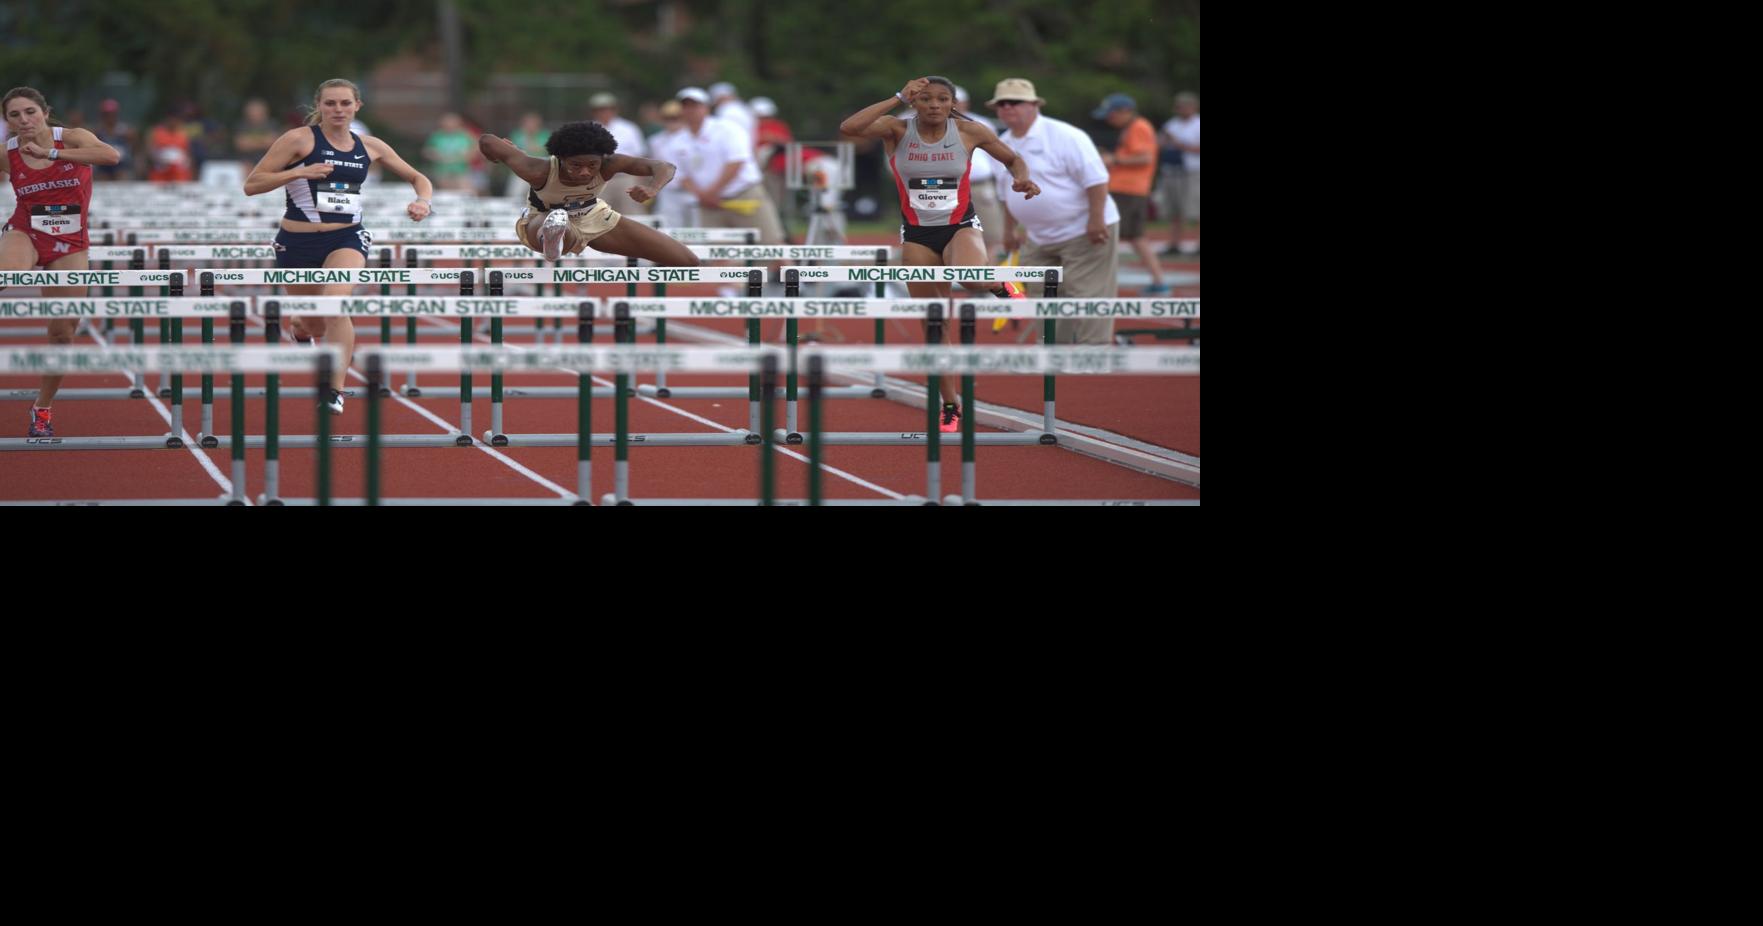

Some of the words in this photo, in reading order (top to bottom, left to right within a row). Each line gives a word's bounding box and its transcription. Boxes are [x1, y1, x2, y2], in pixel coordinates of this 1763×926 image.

[908, 152, 929, 161] OHIO
[931, 152, 954, 161] STATE
[17, 178, 80, 196] NEBRASKA
[327, 196, 351, 205] Black
[53, 241, 71, 253] N
[212, 247, 275, 258] MICHIGA
[459, 247, 534, 258] MICHIGAN
[709, 247, 784, 258] MICHIGAN
[790, 247, 834, 258] STATE
[0, 272, 59, 286] HIGAN
[67, 272, 120, 286] STATE
[148, 274, 170, 282] UCS
[223, 273, 244, 281] UCS
[263, 270, 350, 283] MICHIGAN
[358, 270, 411, 283] STATE
[439, 272, 460, 280] UCS
[513, 271, 534, 279] UCS
[553, 269, 640, 282] MICHIGAN
[647, 269, 700, 282] STATE
[728, 271, 749, 279] UCS
[808, 270, 829, 278] UCS
[848, 268, 935, 281] MICHIGAN
[943, 268, 995, 281] STATE
[1023, 270, 1044, 278] UCS
[106, 300, 169, 315] STATE
[293, 302, 317, 311] UCS
[340, 299, 446, 314] MICHIGAN
[455, 299, 518, 314] STATE
[642, 303, 666, 311] UCS
[690, 301, 794, 315] MICHIGAN
[803, 301, 867, 316] STATE
[987, 304, 1012, 312] UCS
[1036, 301, 1141, 316] MICHIGAN
